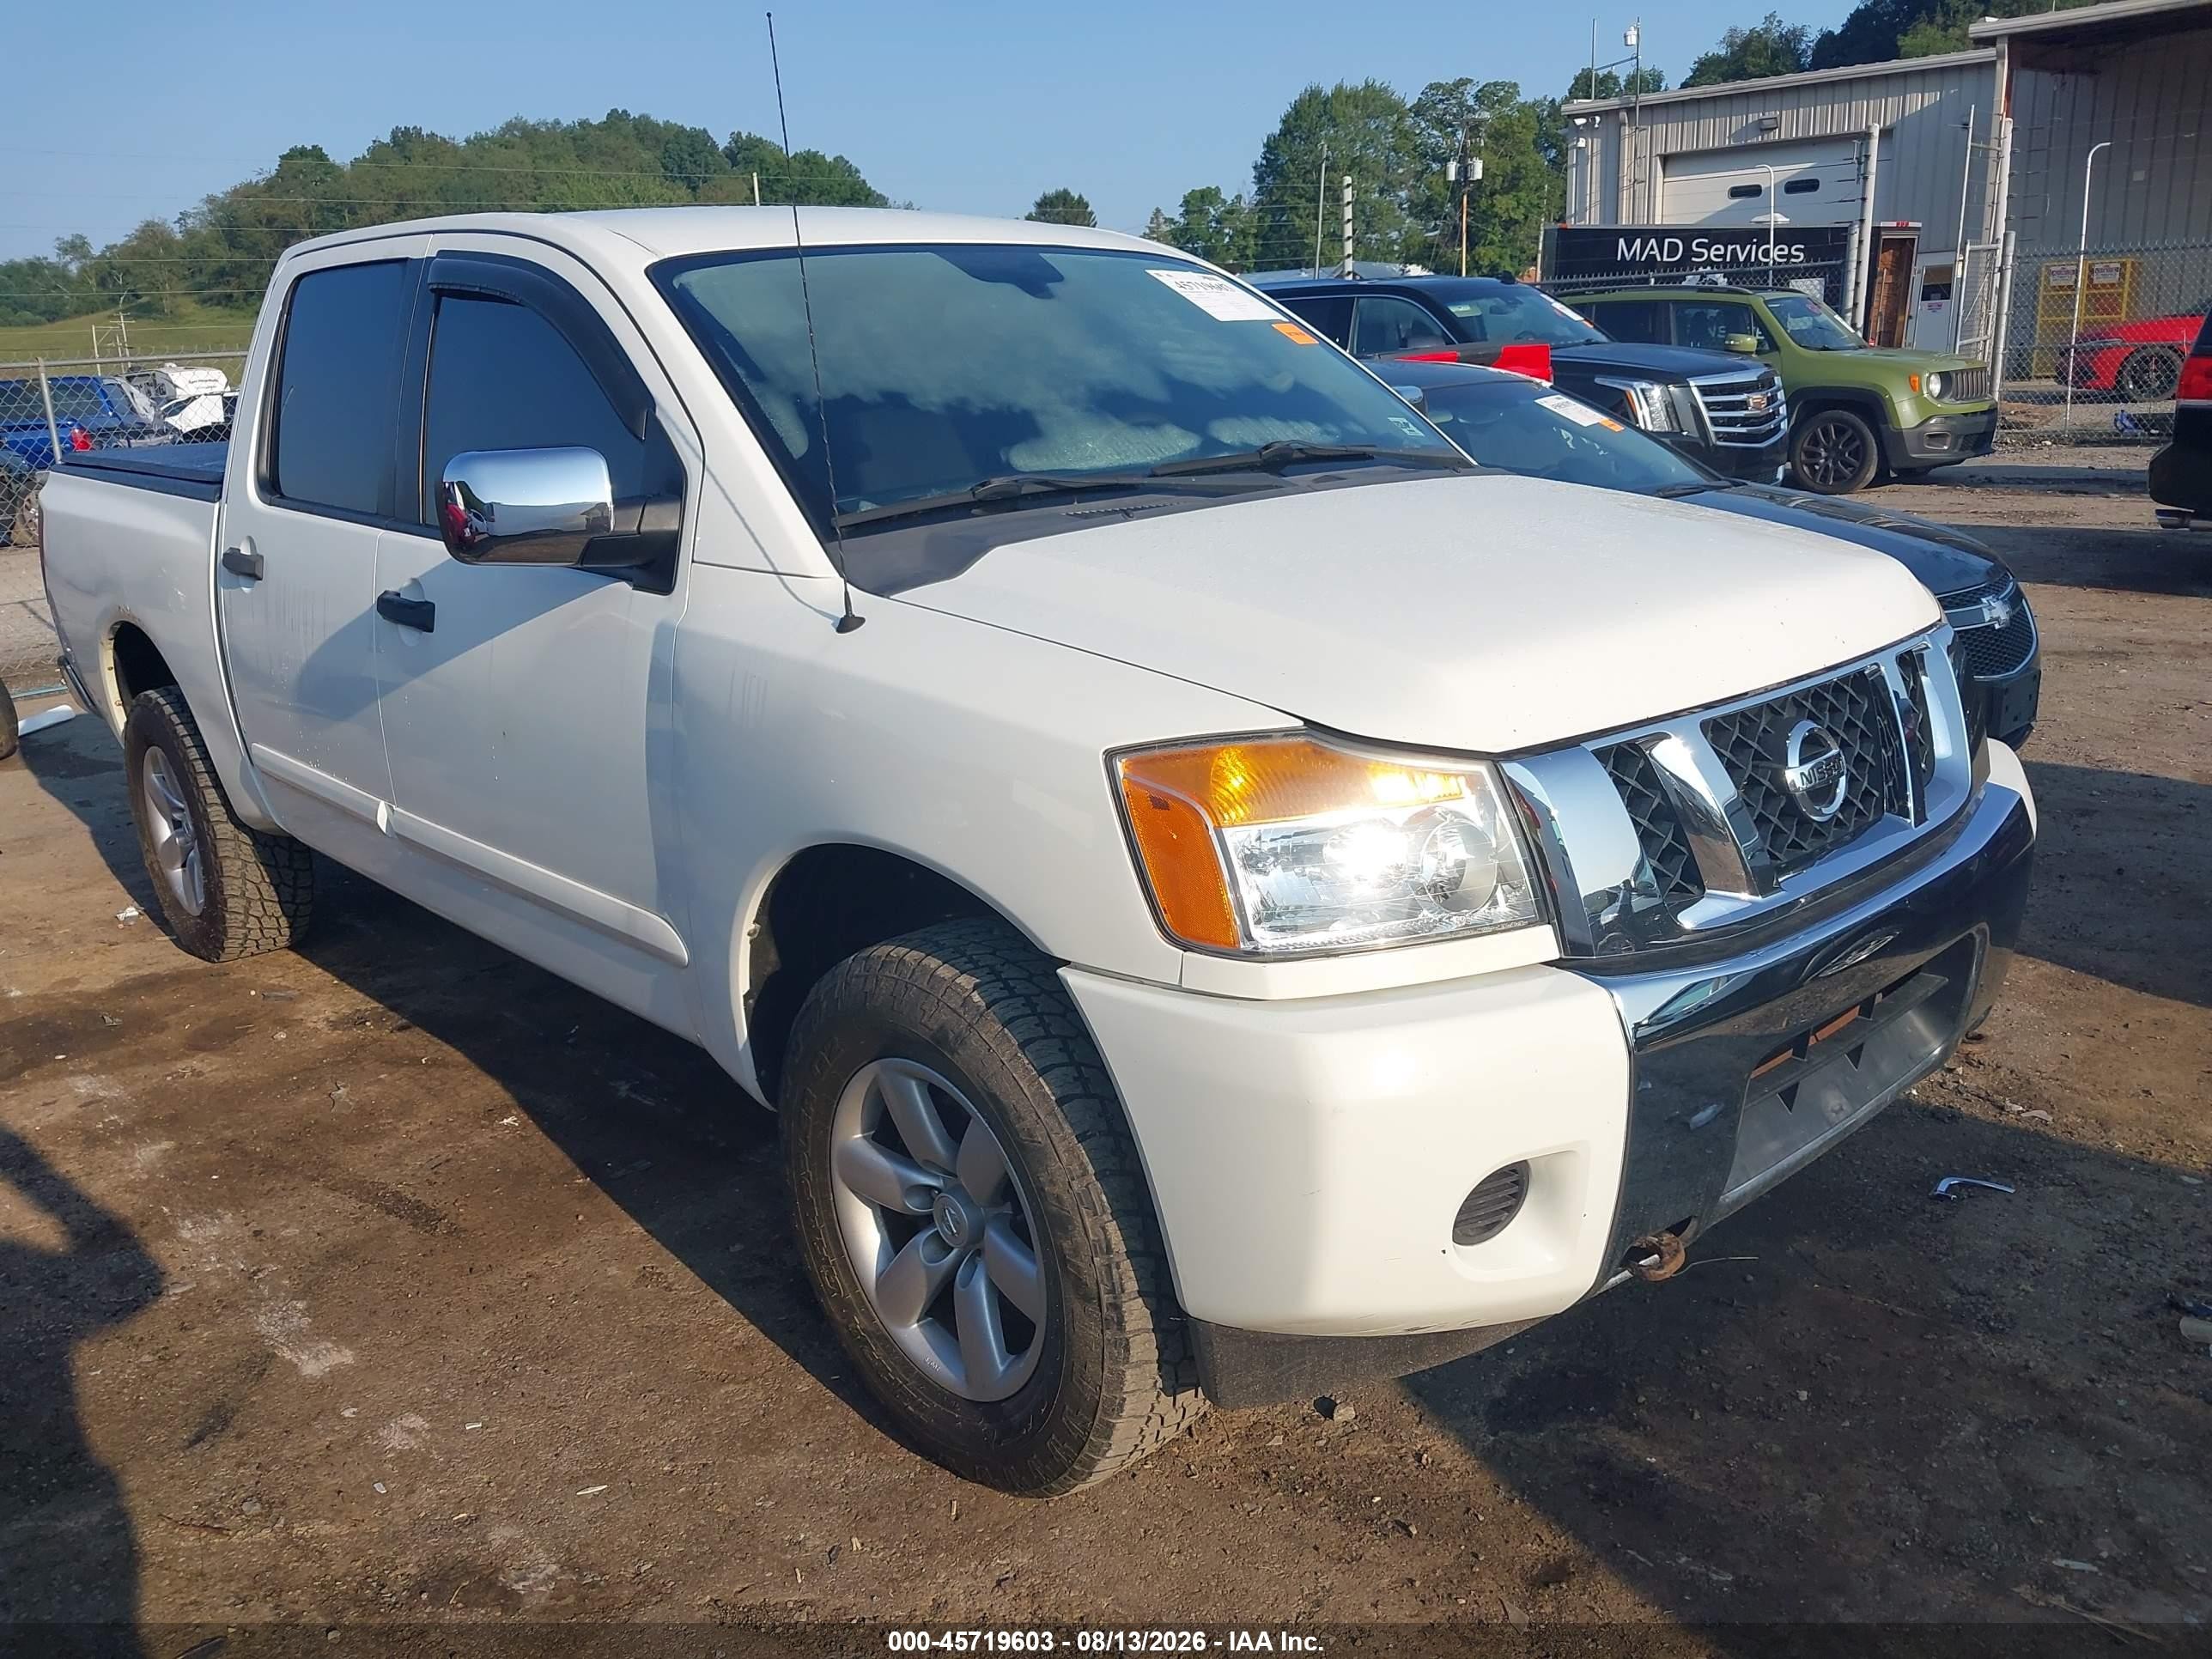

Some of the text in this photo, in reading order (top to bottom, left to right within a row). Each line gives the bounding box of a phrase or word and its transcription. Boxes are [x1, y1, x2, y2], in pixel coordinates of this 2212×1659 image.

[1616, 238, 1805, 262] MAD Services
[1799, 757, 1844, 787] NISSAN
